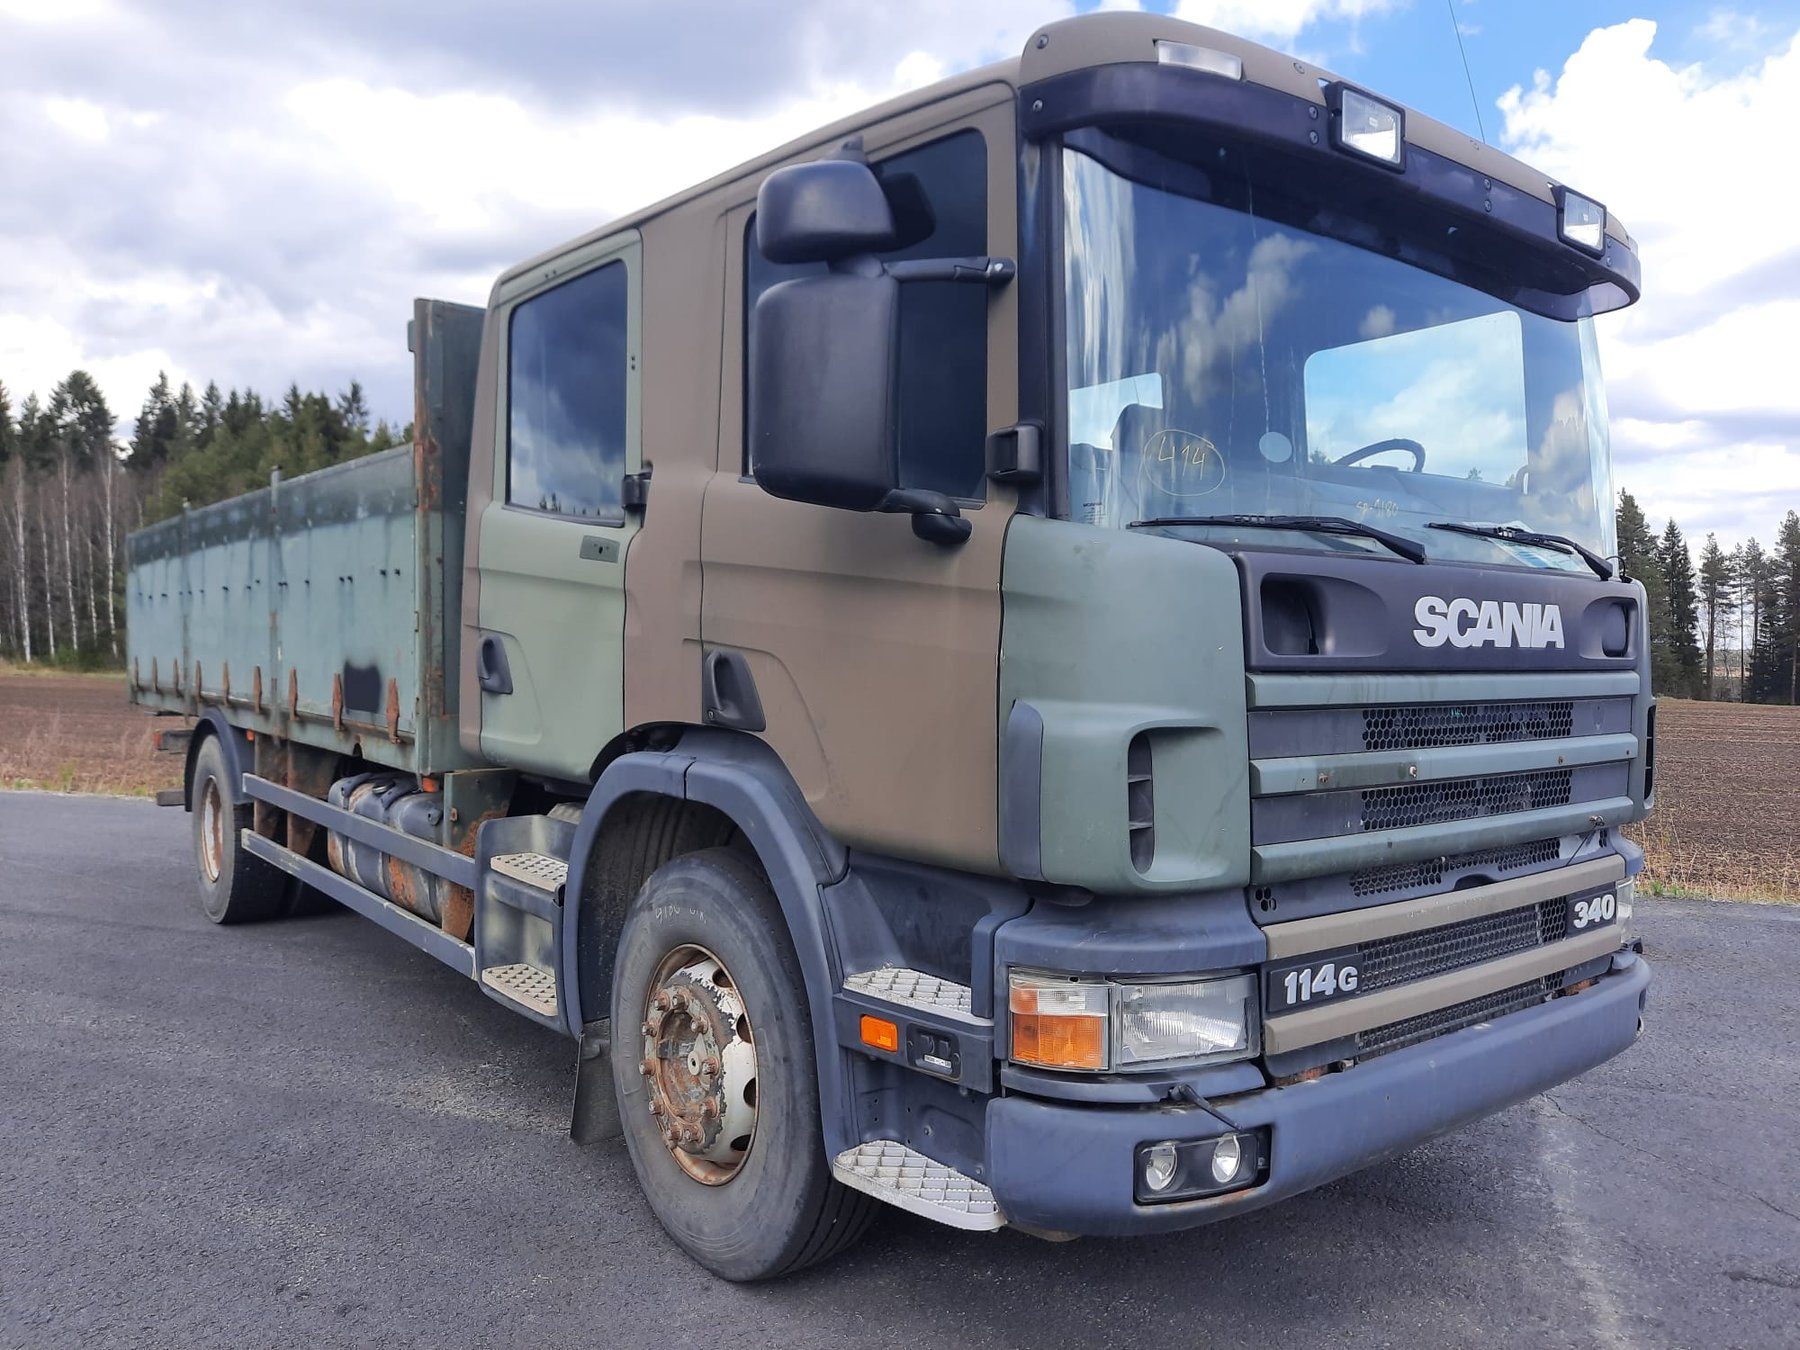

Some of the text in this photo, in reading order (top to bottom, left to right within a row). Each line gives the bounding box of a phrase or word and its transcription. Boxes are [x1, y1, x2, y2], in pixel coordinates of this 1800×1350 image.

[1158, 436, 1205, 480] 414
[1412, 596, 1565, 648] SCANIA
[1573, 894, 1615, 928] 340
[1284, 963, 1358, 1005] 114G
